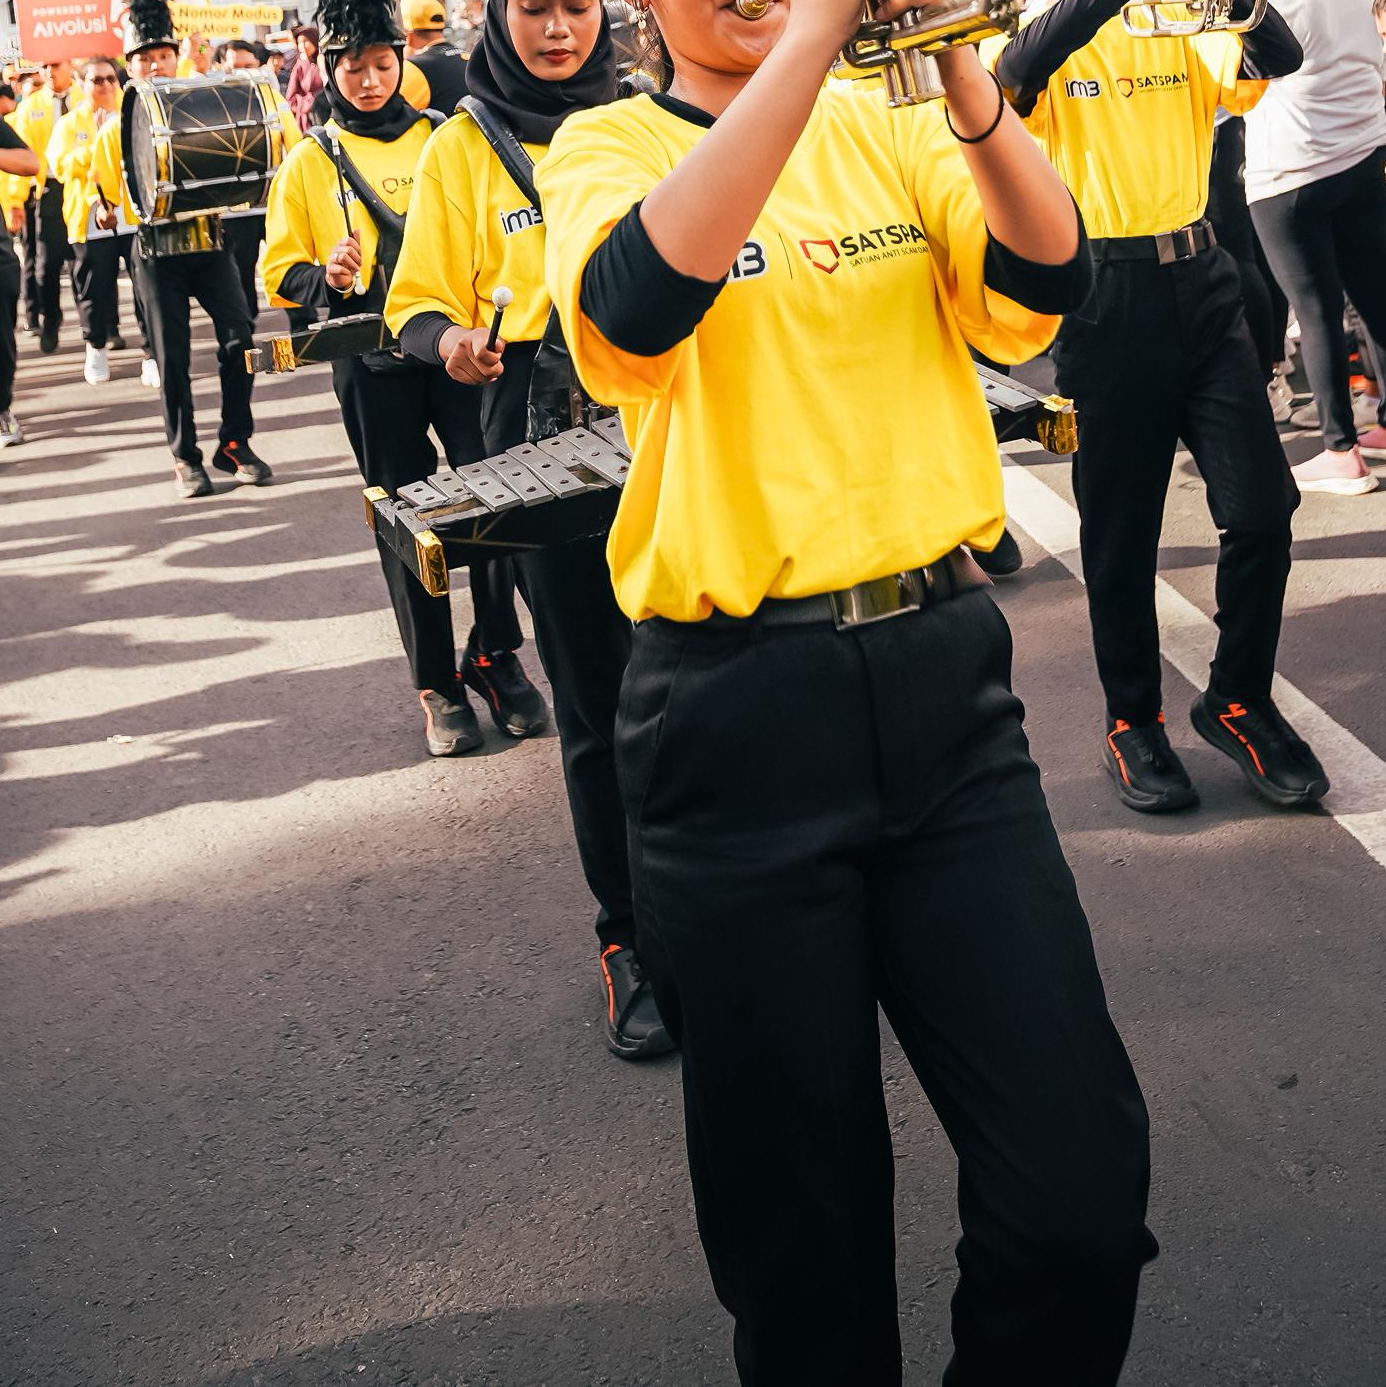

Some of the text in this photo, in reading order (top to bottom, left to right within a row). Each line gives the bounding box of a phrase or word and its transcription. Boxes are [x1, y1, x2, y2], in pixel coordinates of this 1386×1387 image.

[32, 3, 98, 18] POWERED BY
[179, 7, 278, 19] Nomor Modus
[179, 23, 239, 34] No More
[1064, 77, 1101, 98] im3
[850, 254, 881, 268] SATUAN
[882, 248, 901, 259] ANTI
